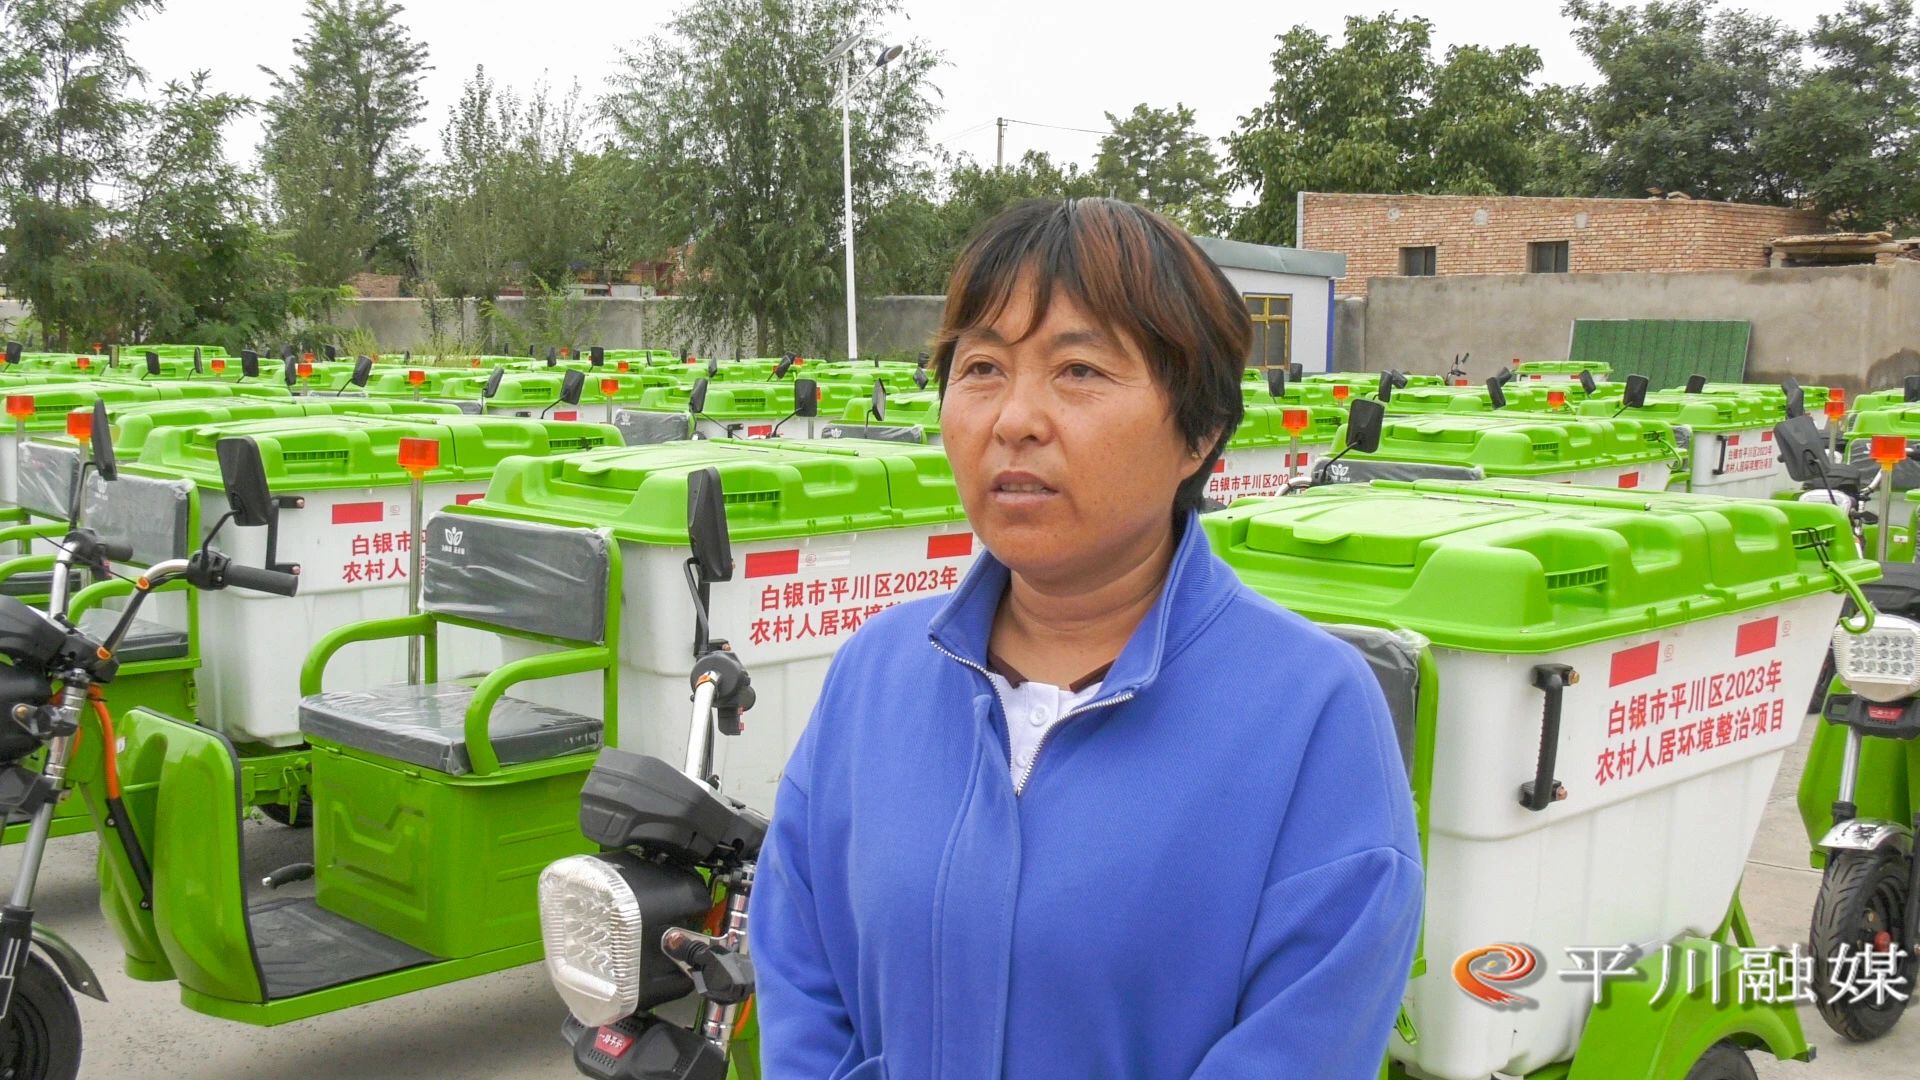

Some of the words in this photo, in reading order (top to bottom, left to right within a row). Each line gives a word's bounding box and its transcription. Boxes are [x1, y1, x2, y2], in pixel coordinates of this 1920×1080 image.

[1209, 472, 1304, 493] 白银市平川区202
[352, 530, 427, 557] 白银市
[342, 557, 425, 584] 农村人
[761, 565, 958, 612] 白银市平川区2023年
[749, 601, 901, 646] 农村人居环
[1608, 659, 1782, 738] 白银市平川区2023年
[1595, 698, 1784, 786] 农村人居环境整治项目
